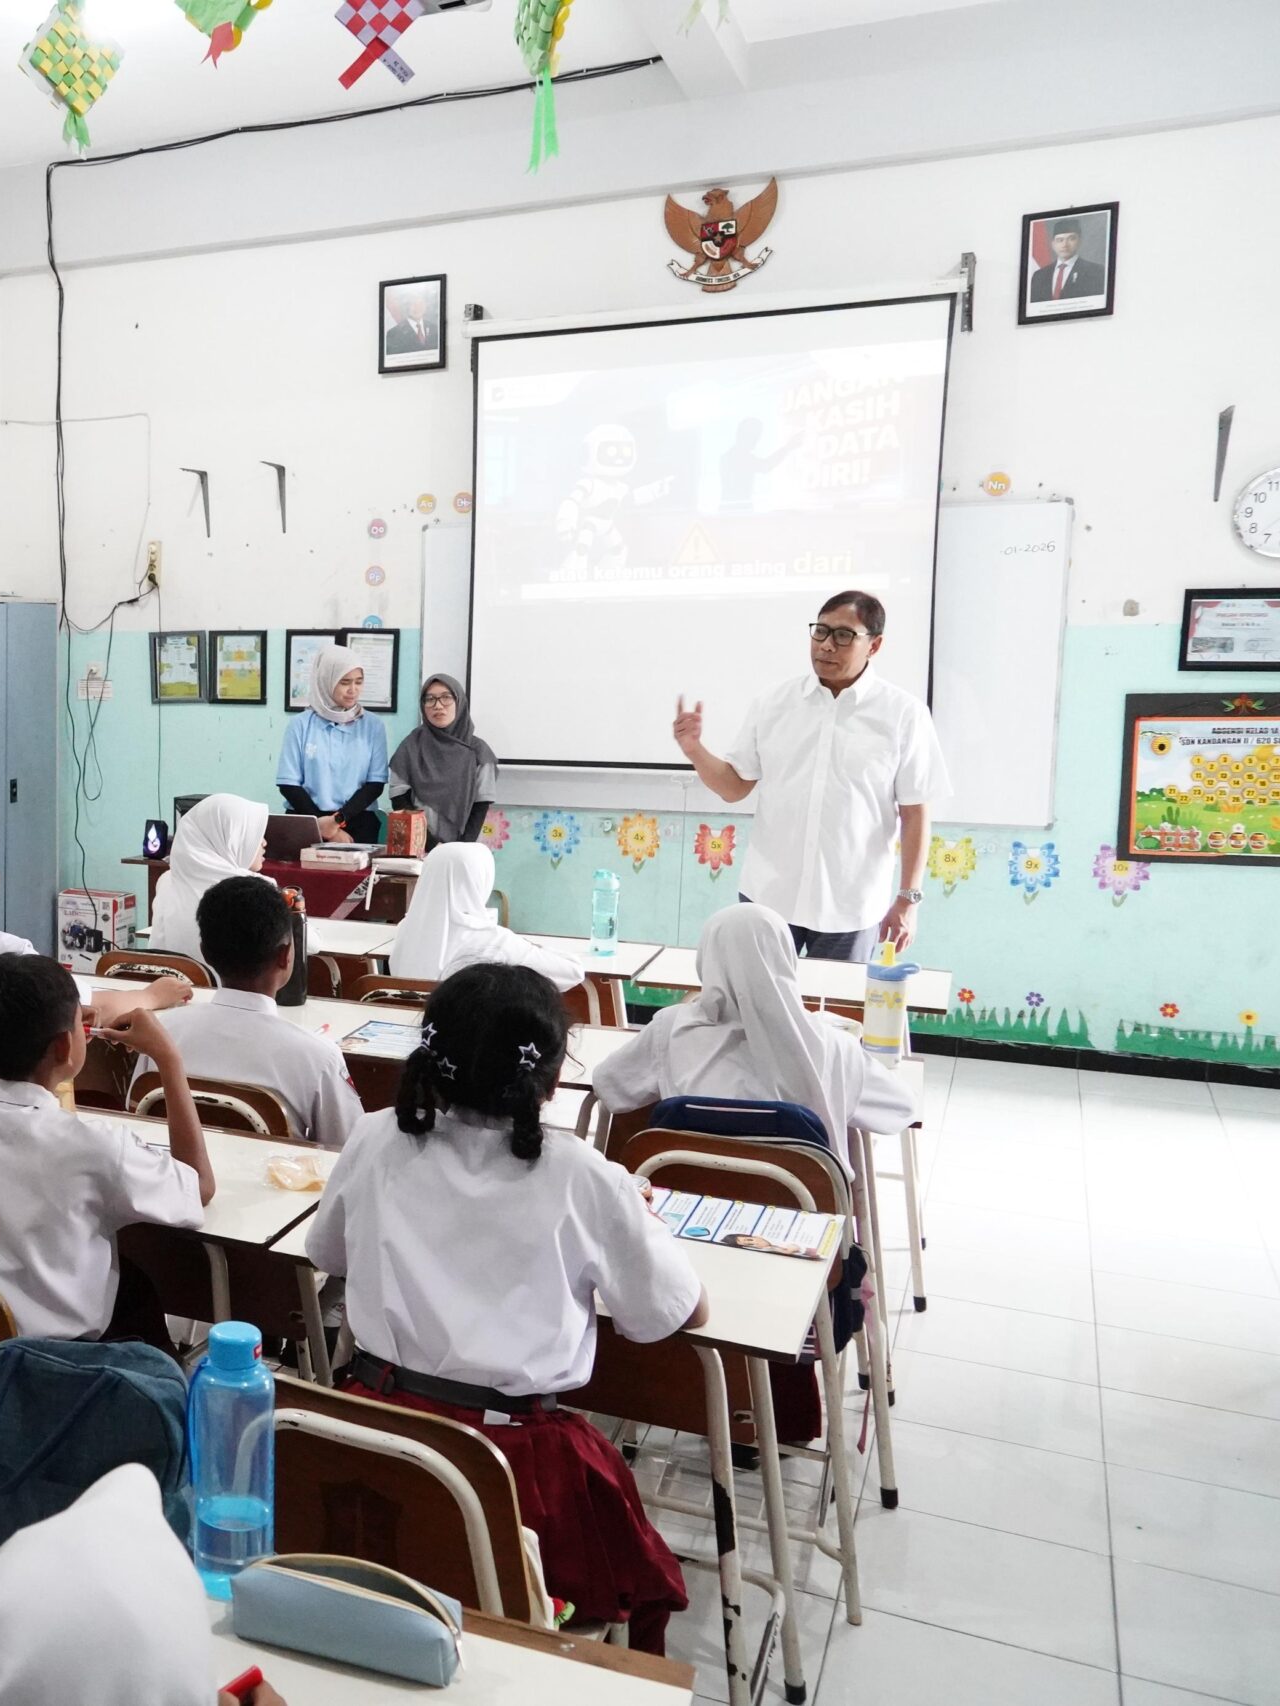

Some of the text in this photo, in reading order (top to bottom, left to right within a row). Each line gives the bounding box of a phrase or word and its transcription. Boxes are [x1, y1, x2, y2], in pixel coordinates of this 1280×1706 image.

[807, 390, 900, 432] KASIH
[817, 423, 900, 460] DATA
[1253, 492, 1267, 503] 10
[1245, 507, 1253, 518] 9
[1249, 523, 1257, 533] 8
[1264, 533, 1272, 544] 7
[730, 560, 786, 578] asing
[793, 549, 852, 575] dari
[552, 829, 563, 839] 3x
[633, 832, 645, 841] 4x
[711, 841, 721, 849] 5x
[944, 853, 957, 863] 8x
[1025, 860, 1039, 869] 9x
[1113, 864, 1128, 872] 10x
